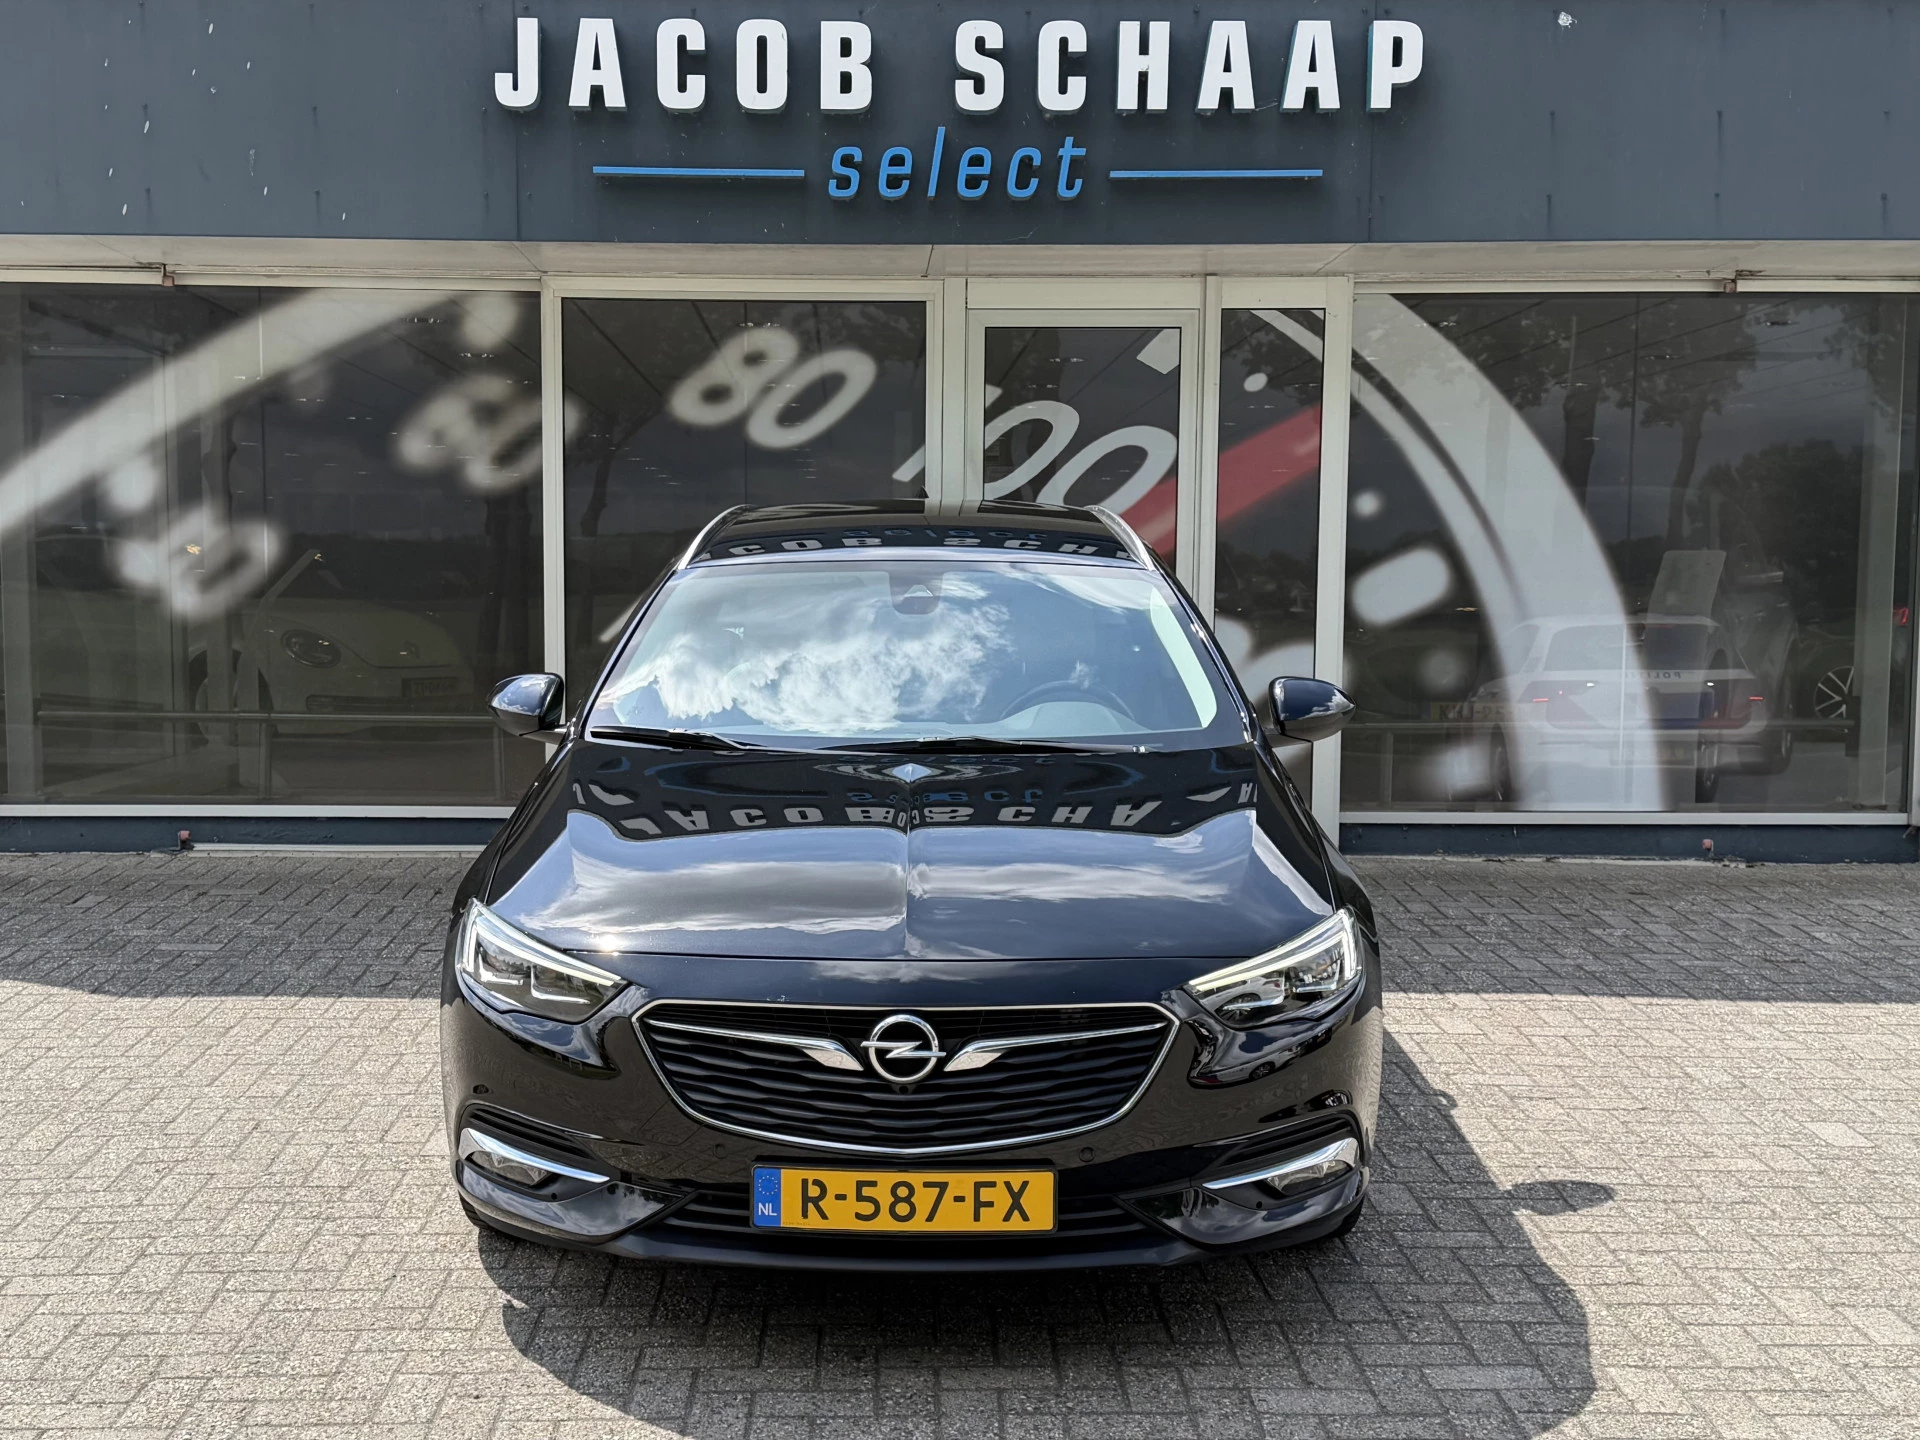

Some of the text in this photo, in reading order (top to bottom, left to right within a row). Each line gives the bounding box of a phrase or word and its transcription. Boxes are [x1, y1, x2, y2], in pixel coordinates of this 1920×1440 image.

[494, 17, 1424, 112] JACOB SCHAAP
[828, 126, 1087, 200] select
[669, 327, 877, 449] 80
[758, 1202, 777, 1216] NL
[801, 1178, 1030, 1223] R-587-FX
